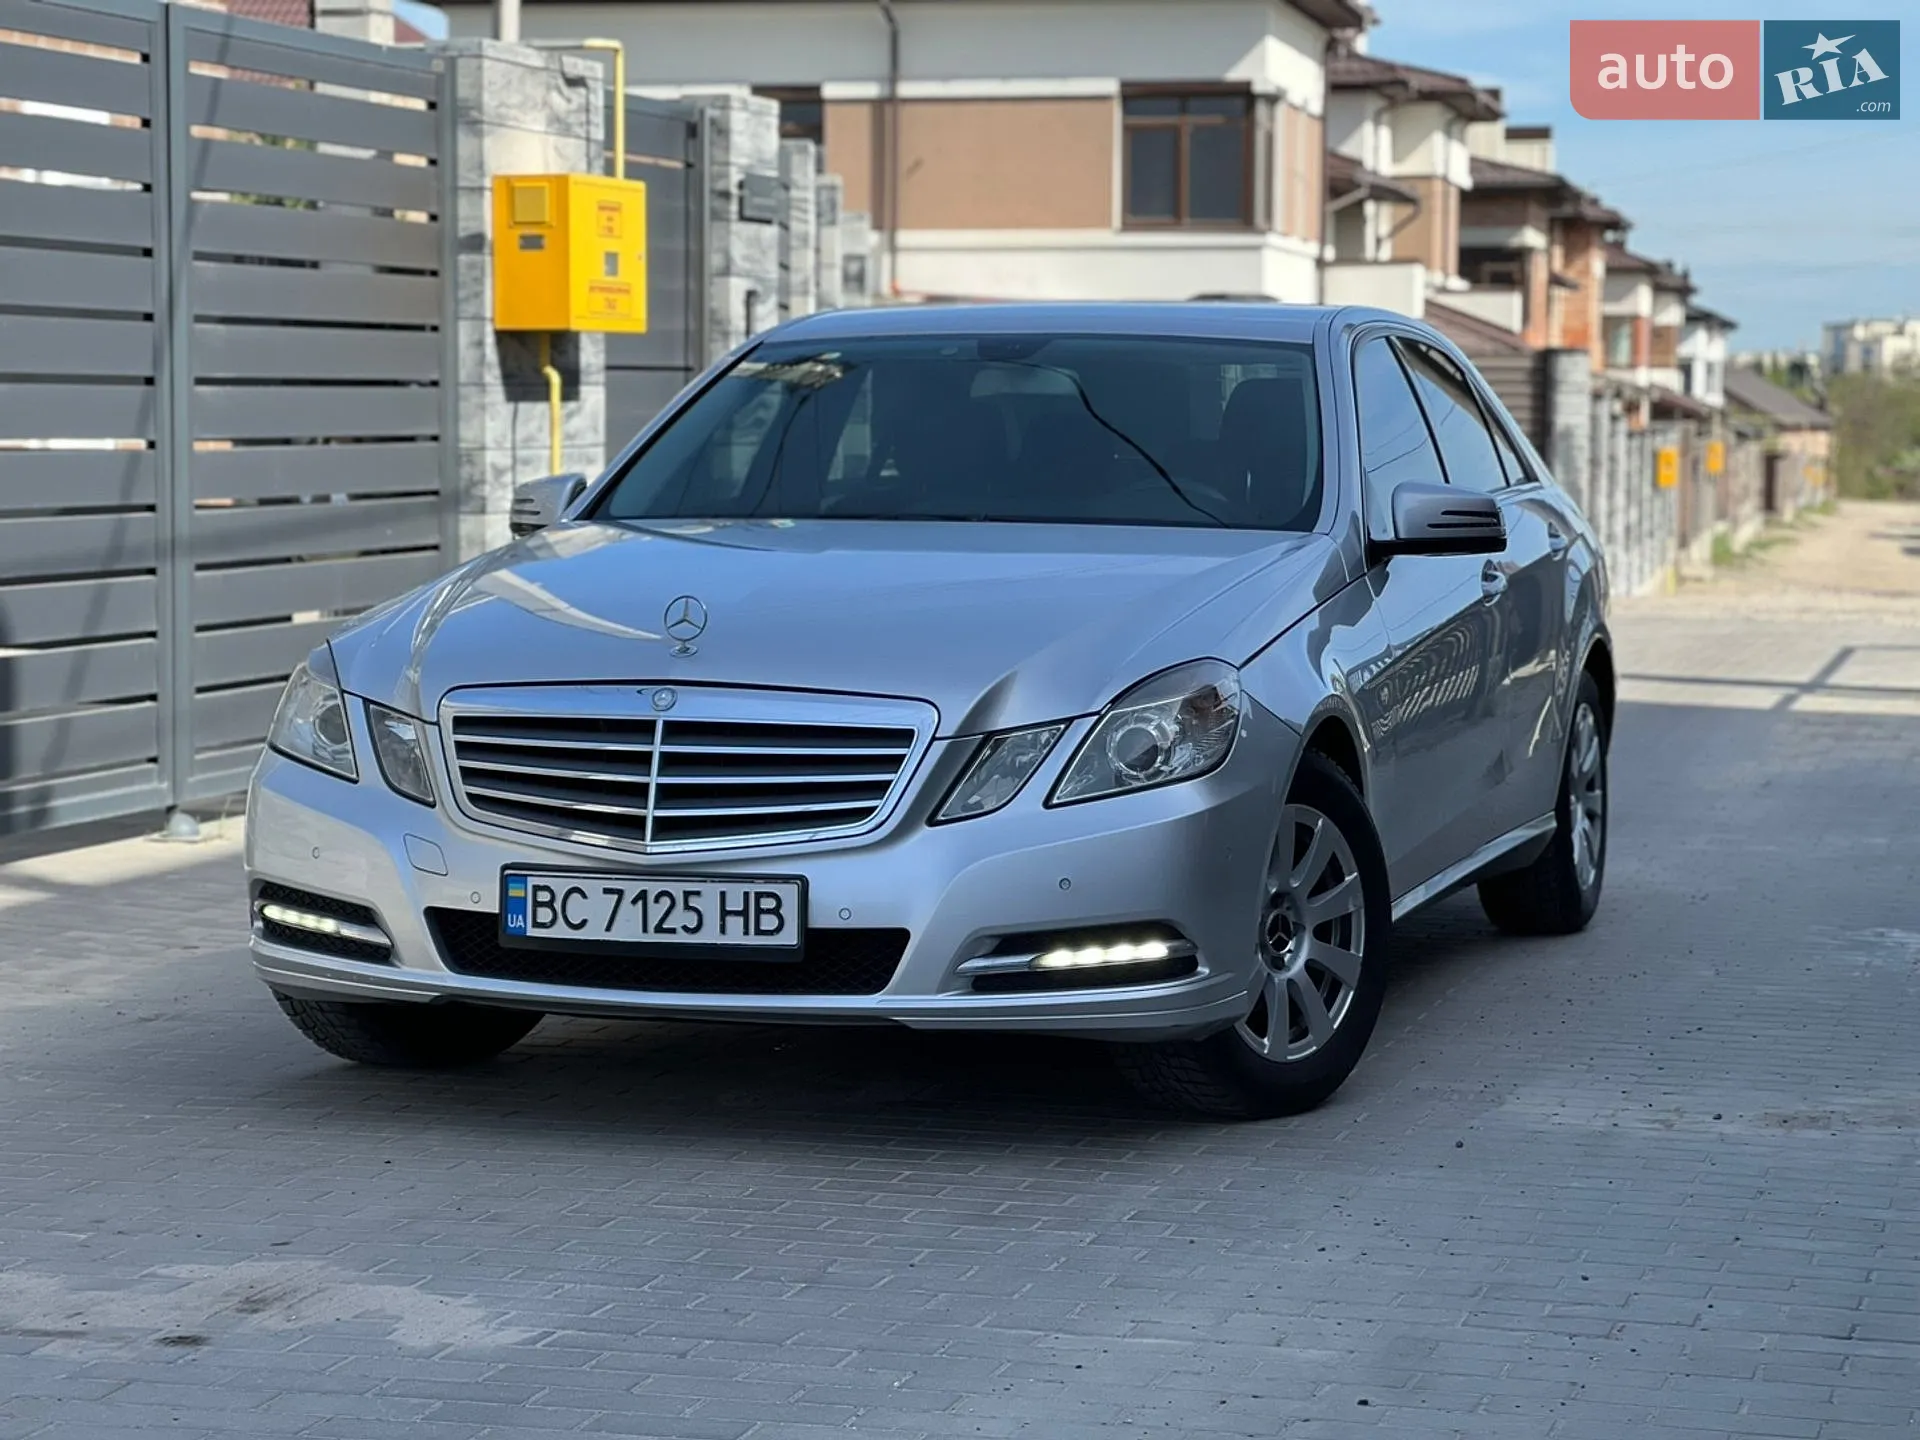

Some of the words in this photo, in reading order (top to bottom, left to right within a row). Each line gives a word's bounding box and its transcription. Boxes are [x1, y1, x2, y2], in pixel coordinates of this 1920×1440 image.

[507, 914, 525, 928] UA
[531, 884, 589, 931] BC
[602, 887, 704, 934] 7125
[719, 890, 785, 936] HB
